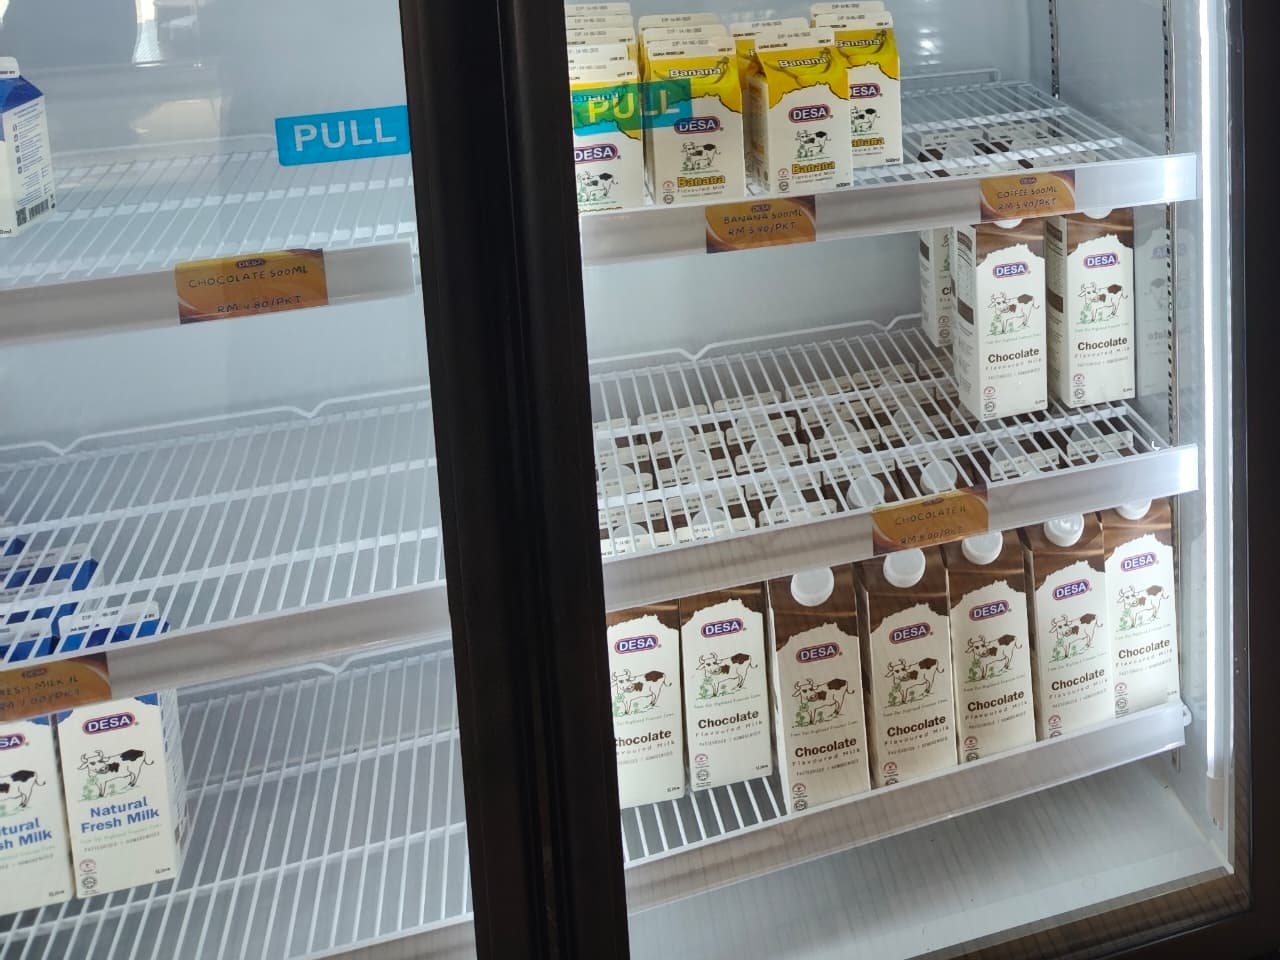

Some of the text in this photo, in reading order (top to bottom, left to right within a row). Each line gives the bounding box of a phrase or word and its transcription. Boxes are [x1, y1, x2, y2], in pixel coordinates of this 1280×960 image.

[836, 39, 881, 48] Banana
[778, 57, 827, 68] Banana
[669, 67, 721, 78] Banana
[588, 90, 680, 123] PULL
[793, 108, 827, 120] DESA
[679, 120, 716, 132] DESA
[293, 117, 397, 152] PULL
[851, 137, 885, 147] anana
[575, 147, 613, 161] DESA
[791, 161, 835, 175] Banana
[676, 175, 725, 188] Banana
[997, 190, 1029, 199] COFFEE
[724, 215, 768, 224] BANANA
[1087, 255, 1116, 267] DESA
[996, 264, 1026, 277] DESA
[189, 272, 265, 288] CHOCOLATE
[1077, 336, 1128, 351] Chocolate
[987, 347, 1040, 363] Chocolate
[895, 507, 957, 525] CHOCOLATE
[1124, 555, 1154, 570] DESA
[1056, 583, 1088, 598] DESA
[973, 604, 1006, 619] DESA
[705, 621, 741, 635] DESA
[893, 626, 928, 641] DESA
[619, 638, 655, 651] DESA
[1118, 639, 1170, 659] Chocolate
[800, 646, 836, 660] DESA
[1051, 668, 1105, 691] Chocolate
[1049, 685, 1090, 700] Flavoured
[967, 690, 1025, 712] Chocolate
[698, 710, 759, 729] Chocolate
[965, 707, 1008, 720] Flavoured
[88, 715, 131, 733] DESA
[887, 715, 946, 737] Chocolate
[0, 735, 21, 748] SA
[795, 738, 857, 758] Chocolate
[90, 796, 148, 818] Natural
[0, 817, 40, 837] tural
[81, 817, 122, 833] Fresh
[126, 808, 160, 825] Milk
[19, 830, 53, 847] Milk
